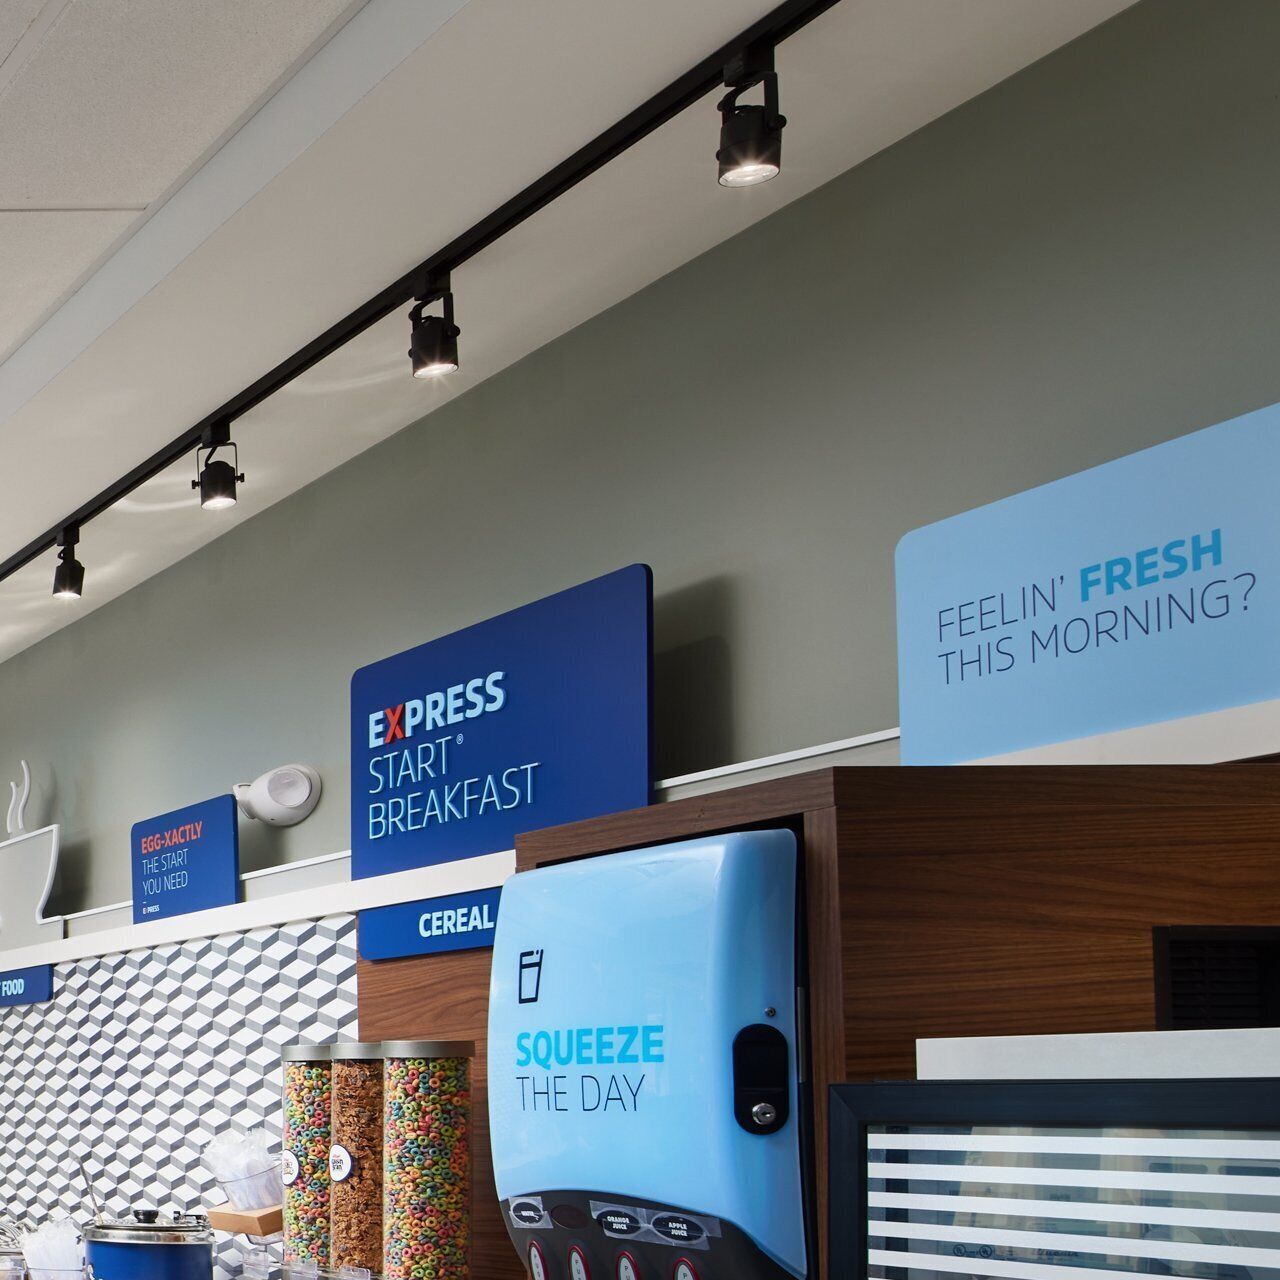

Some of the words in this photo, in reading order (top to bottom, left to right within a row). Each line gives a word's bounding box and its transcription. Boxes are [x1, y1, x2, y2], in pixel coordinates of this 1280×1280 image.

[938, 575, 1065, 643] FEELIN'
[1078, 528, 1223, 603] FRESH
[937, 636, 1015, 685] THIS
[1031, 571, 1258, 664] MORNING?
[369, 671, 505, 749] EXPRESS
[369, 762, 540, 839] BREAKFAST
[141, 821, 203, 854] EGG-XACTLY
[142, 856, 159, 875] THE
[161, 848, 189, 871] START
[142, 877, 162, 896] YOU
[164, 871, 188, 892] NEED
[143, 904, 160, 915] EXPRESS
[419, 904, 495, 938] CEREAL
[1, 978, 25, 997] FOOD
[516, 1025, 665, 1071] SQUEEZE
[516, 1075, 569, 1111] THE
[581, 1074, 646, 1112] DAY
[668, 1222, 688, 1230] APPLE
